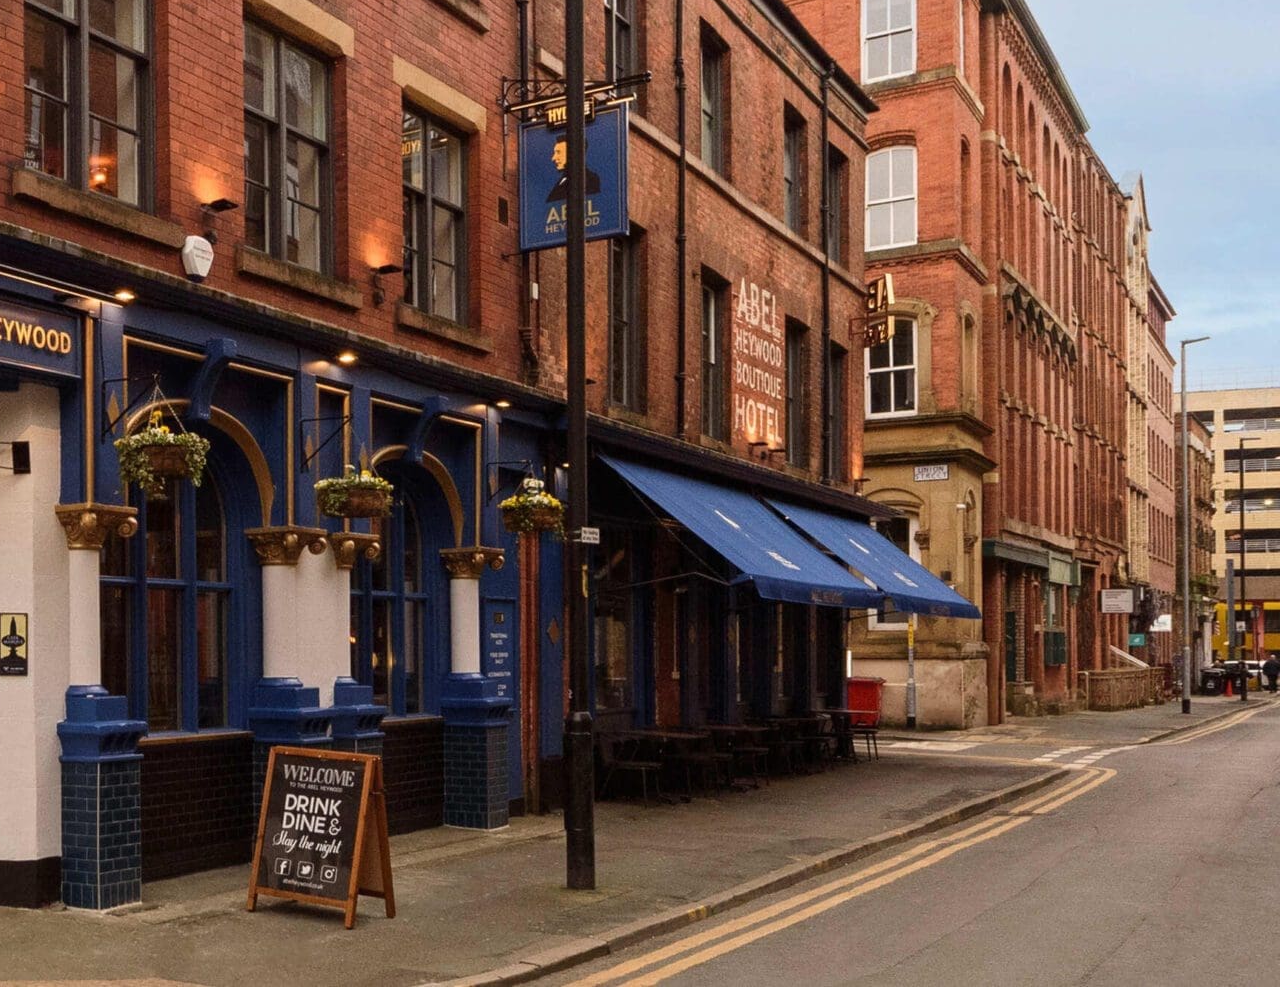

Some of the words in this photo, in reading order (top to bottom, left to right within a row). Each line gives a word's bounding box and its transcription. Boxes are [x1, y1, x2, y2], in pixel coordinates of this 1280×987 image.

[545, 216, 600, 234] HEYOD
[546, 200, 600, 224] AL
[736, 277, 782, 335] ABEL
[735, 329, 782, 367] HEYWOOD
[735, 360, 782, 400] BOUTIQUE
[735, 394, 782, 443] HOTEL
[283, 764, 355, 787] WELCOME
[284, 793, 342, 817] DRINK
[282, 812, 326, 834] DINE
[328, 818, 342, 836] &
[272, 830, 297, 853] Stay
[298, 835, 314, 850] the
[315, 839, 342, 859] night
